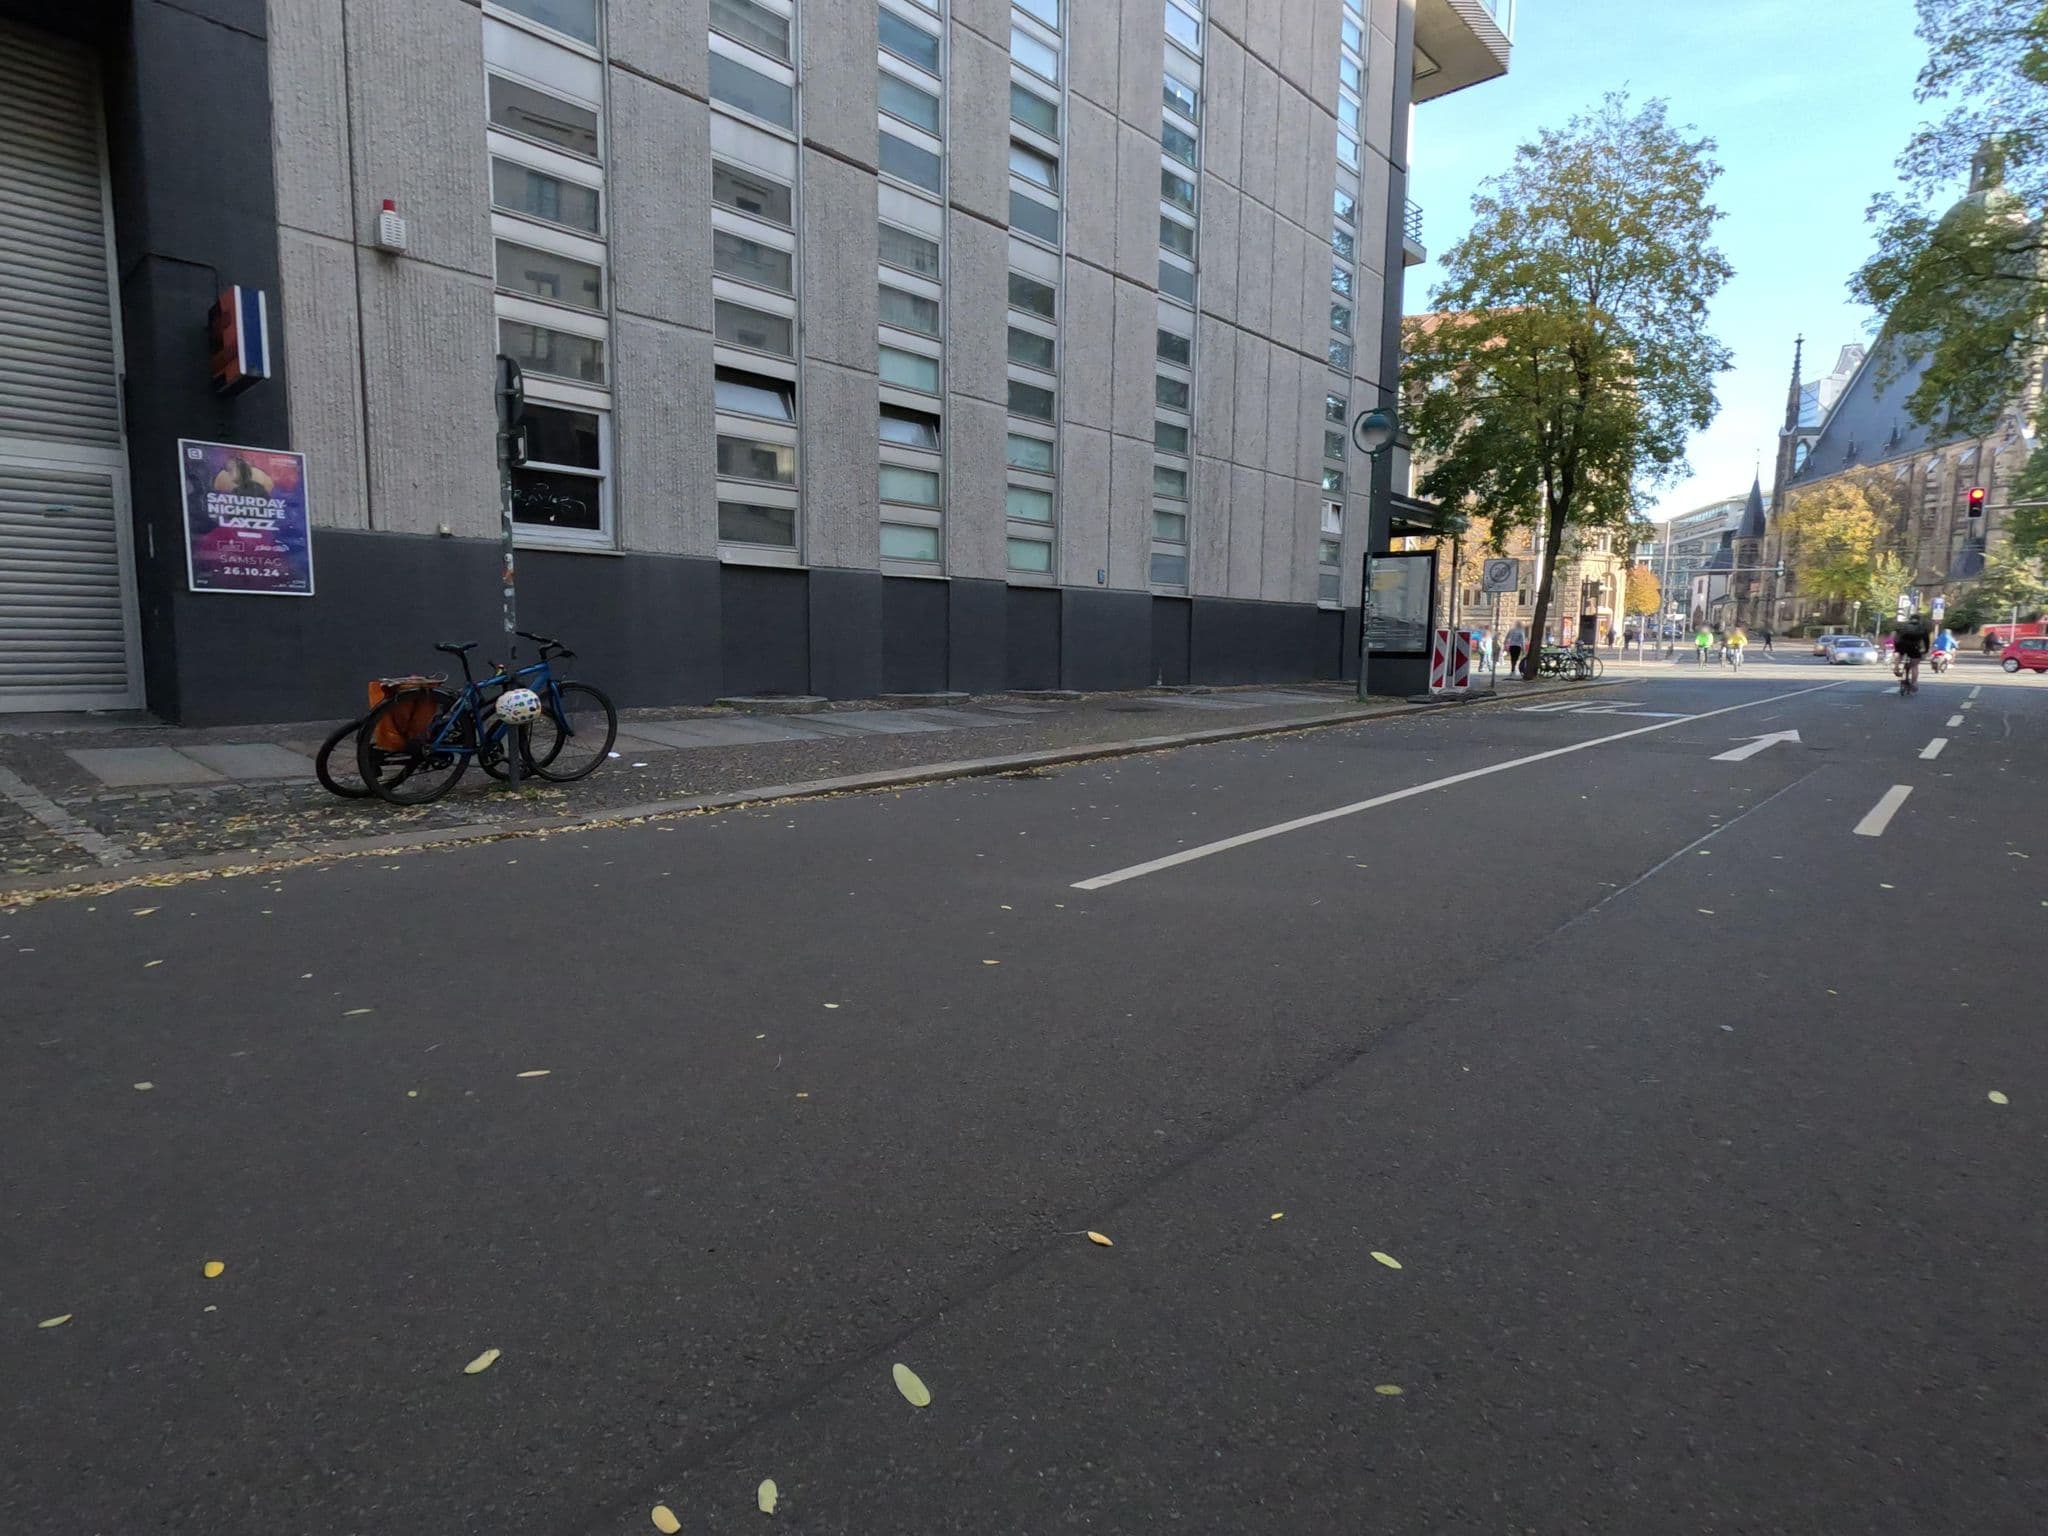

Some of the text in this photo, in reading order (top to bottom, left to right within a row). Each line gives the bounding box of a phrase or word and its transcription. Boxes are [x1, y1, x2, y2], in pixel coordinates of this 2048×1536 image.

[207, 492, 286, 508] SATURDAY
[207, 503, 286, 519] NIGHTLIFE
[219, 554, 282, 567] SAMSTAG
[223, 566, 280, 577] 26.10.24
